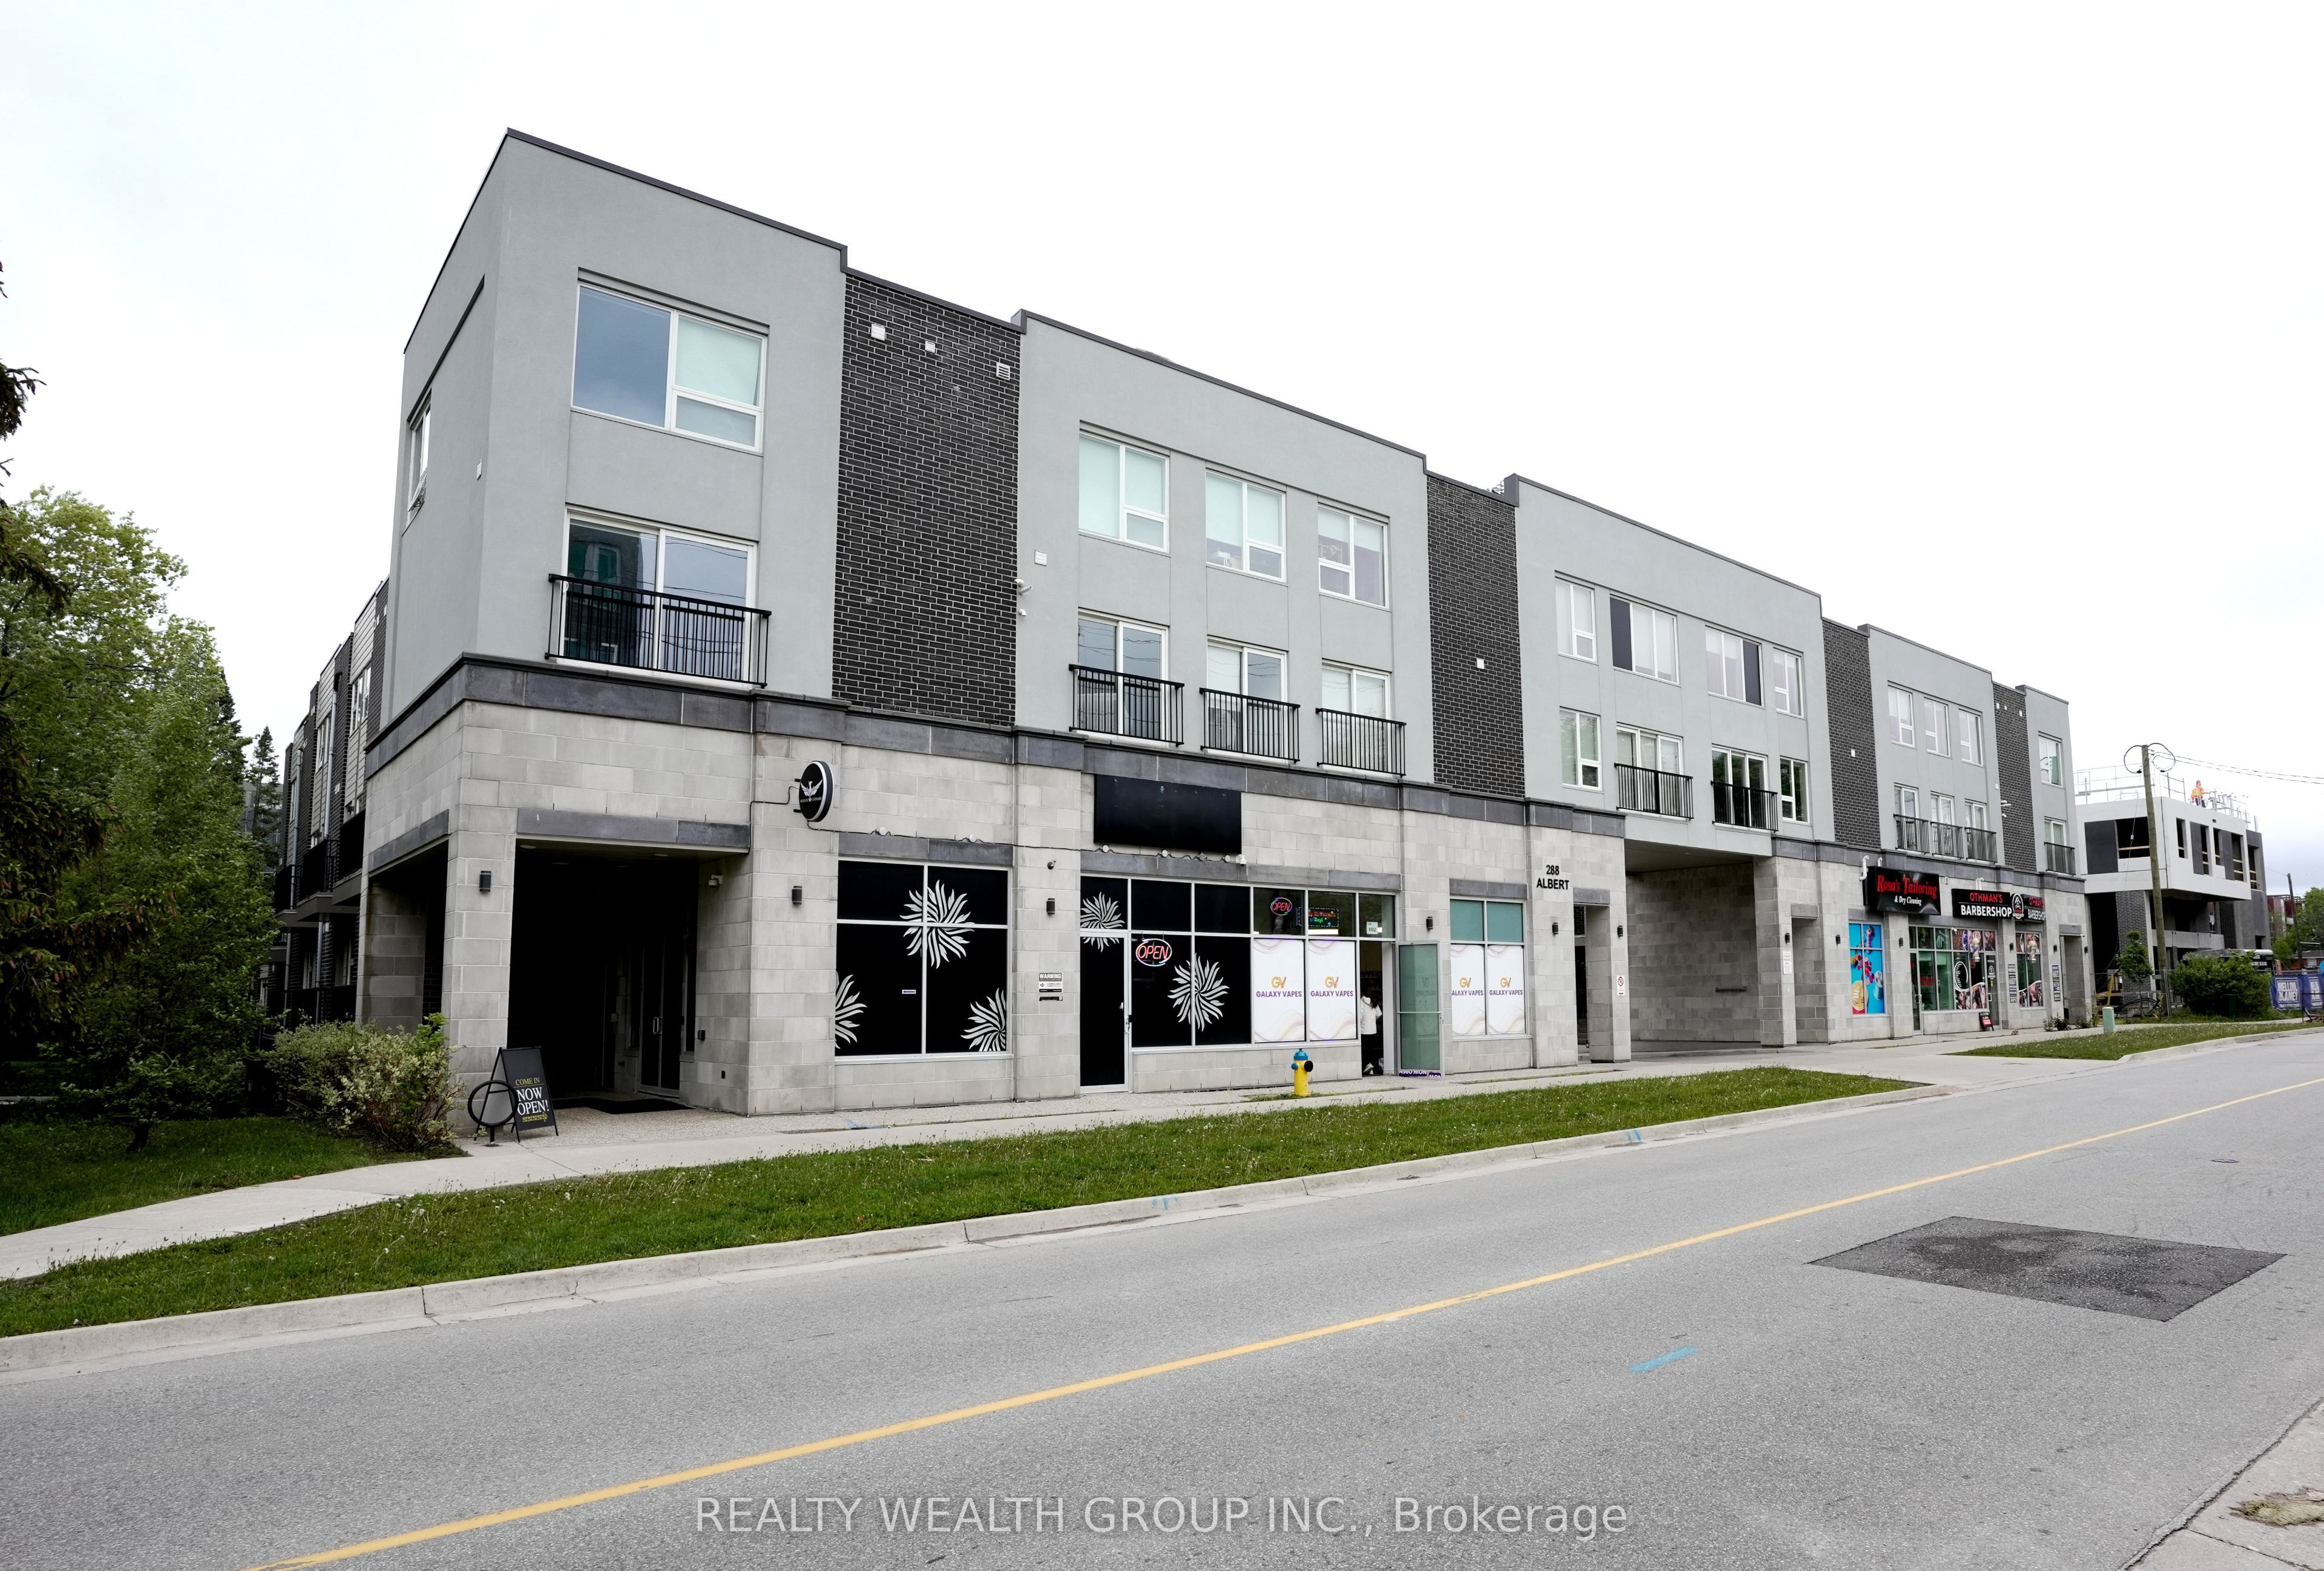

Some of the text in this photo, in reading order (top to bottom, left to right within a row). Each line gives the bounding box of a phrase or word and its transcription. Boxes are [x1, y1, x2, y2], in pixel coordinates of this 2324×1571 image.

[1546, 865, 1560, 875] 288
[1537, 877, 1569, 890] ALBERT
[1877, 874, 1937, 899] Rosa's Tailoring
[1907, 896, 1922, 907] Cleaning
[1969, 892, 2003, 904] OTHMAN'S
[1272, 902, 1290, 911] OPEN
[1961, 905, 2012, 917] BARBERSHOP
[1138, 945, 1169, 959] OPEN
[516, 1087, 542, 1101] NOW
[517, 1099, 549, 1115] OPEN!
